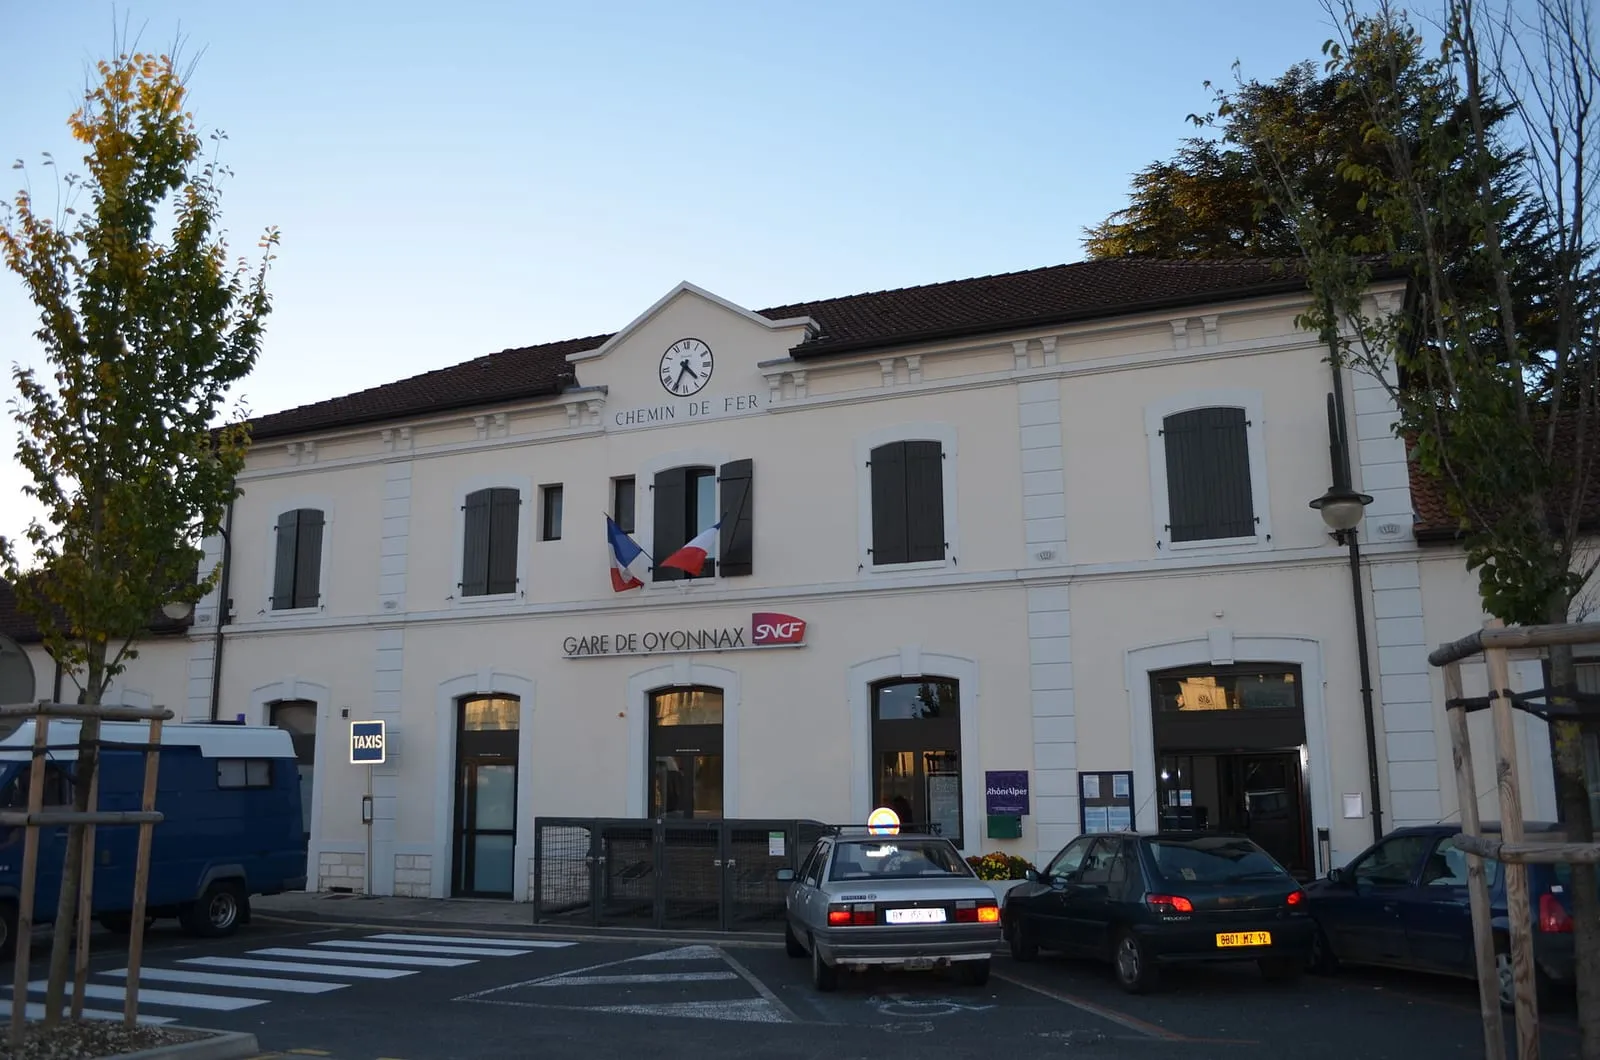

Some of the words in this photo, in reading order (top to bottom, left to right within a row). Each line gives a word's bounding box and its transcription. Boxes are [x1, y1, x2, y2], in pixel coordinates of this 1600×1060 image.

[615, 406, 675, 426] CHEMIN
[689, 401, 710, 417] DE
[724, 395, 758, 412] FER
[563, 634, 609, 656] GARE
[615, 633, 637, 654] DE
[642, 627, 745, 652] OYONNAX
[754, 622, 803, 640] SNCF
[353, 734, 383, 749] TAXIS
